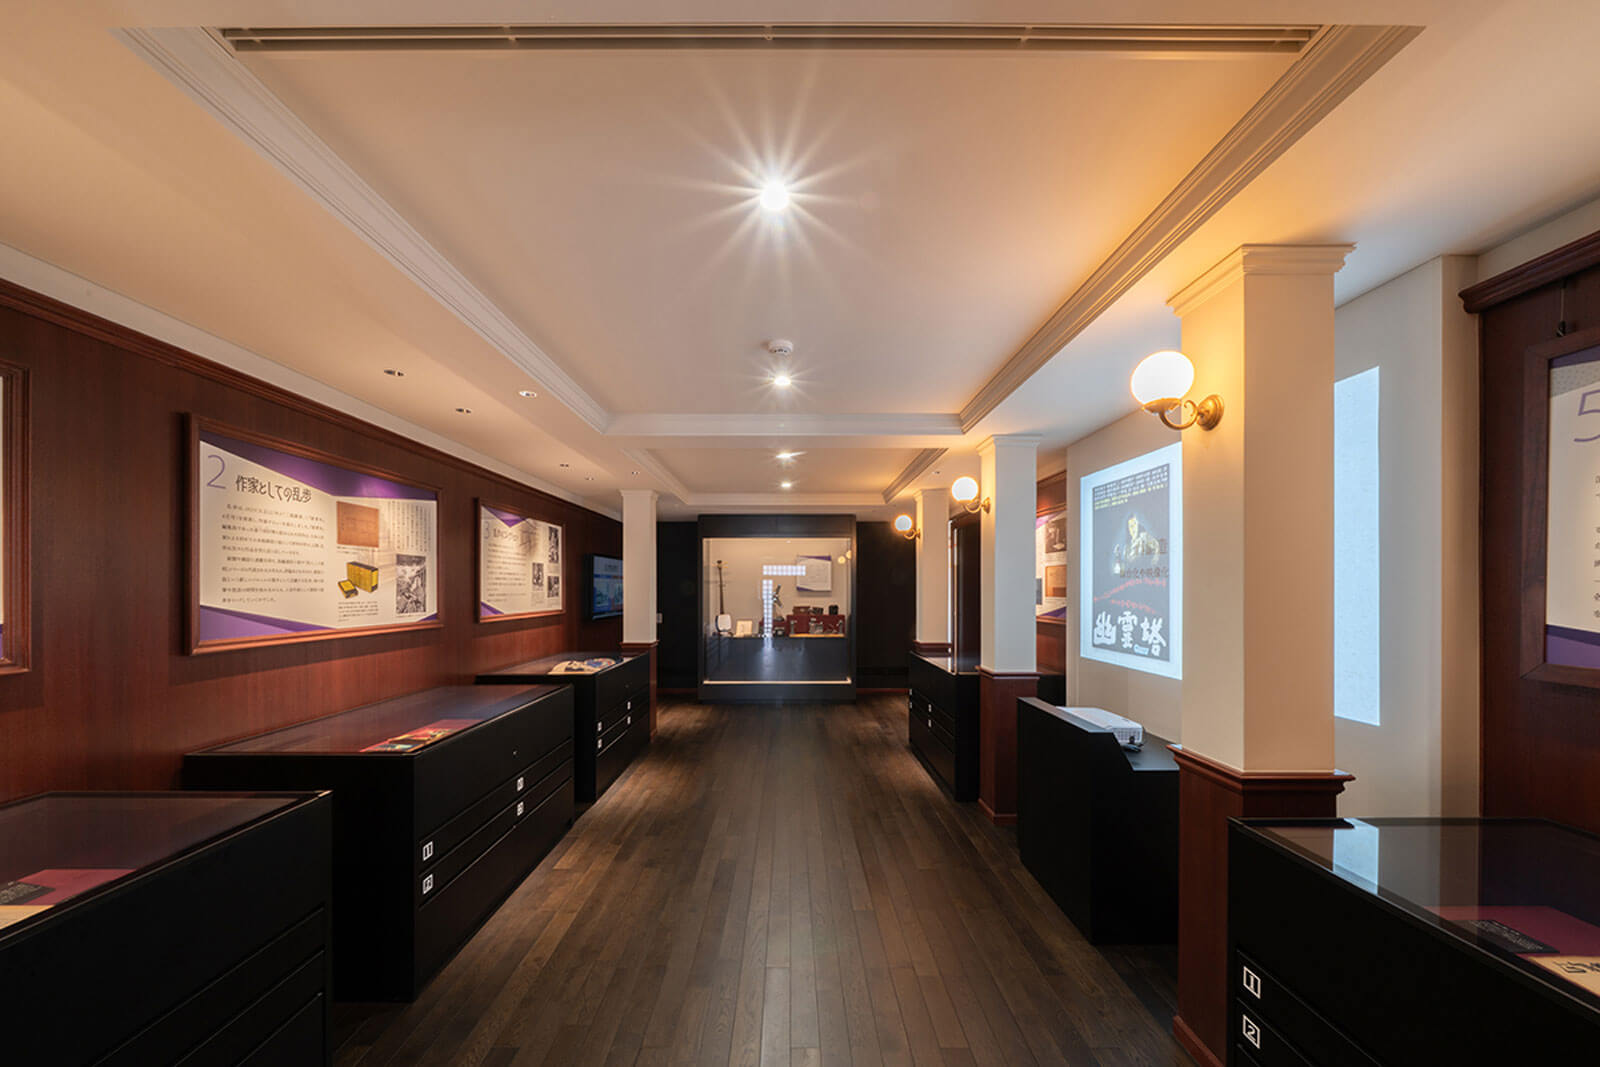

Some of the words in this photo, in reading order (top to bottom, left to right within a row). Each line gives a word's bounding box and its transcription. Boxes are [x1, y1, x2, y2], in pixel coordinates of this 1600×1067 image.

[206, 454, 227, 490] 2
[235, 474, 312, 503] 作家としての乱歩
